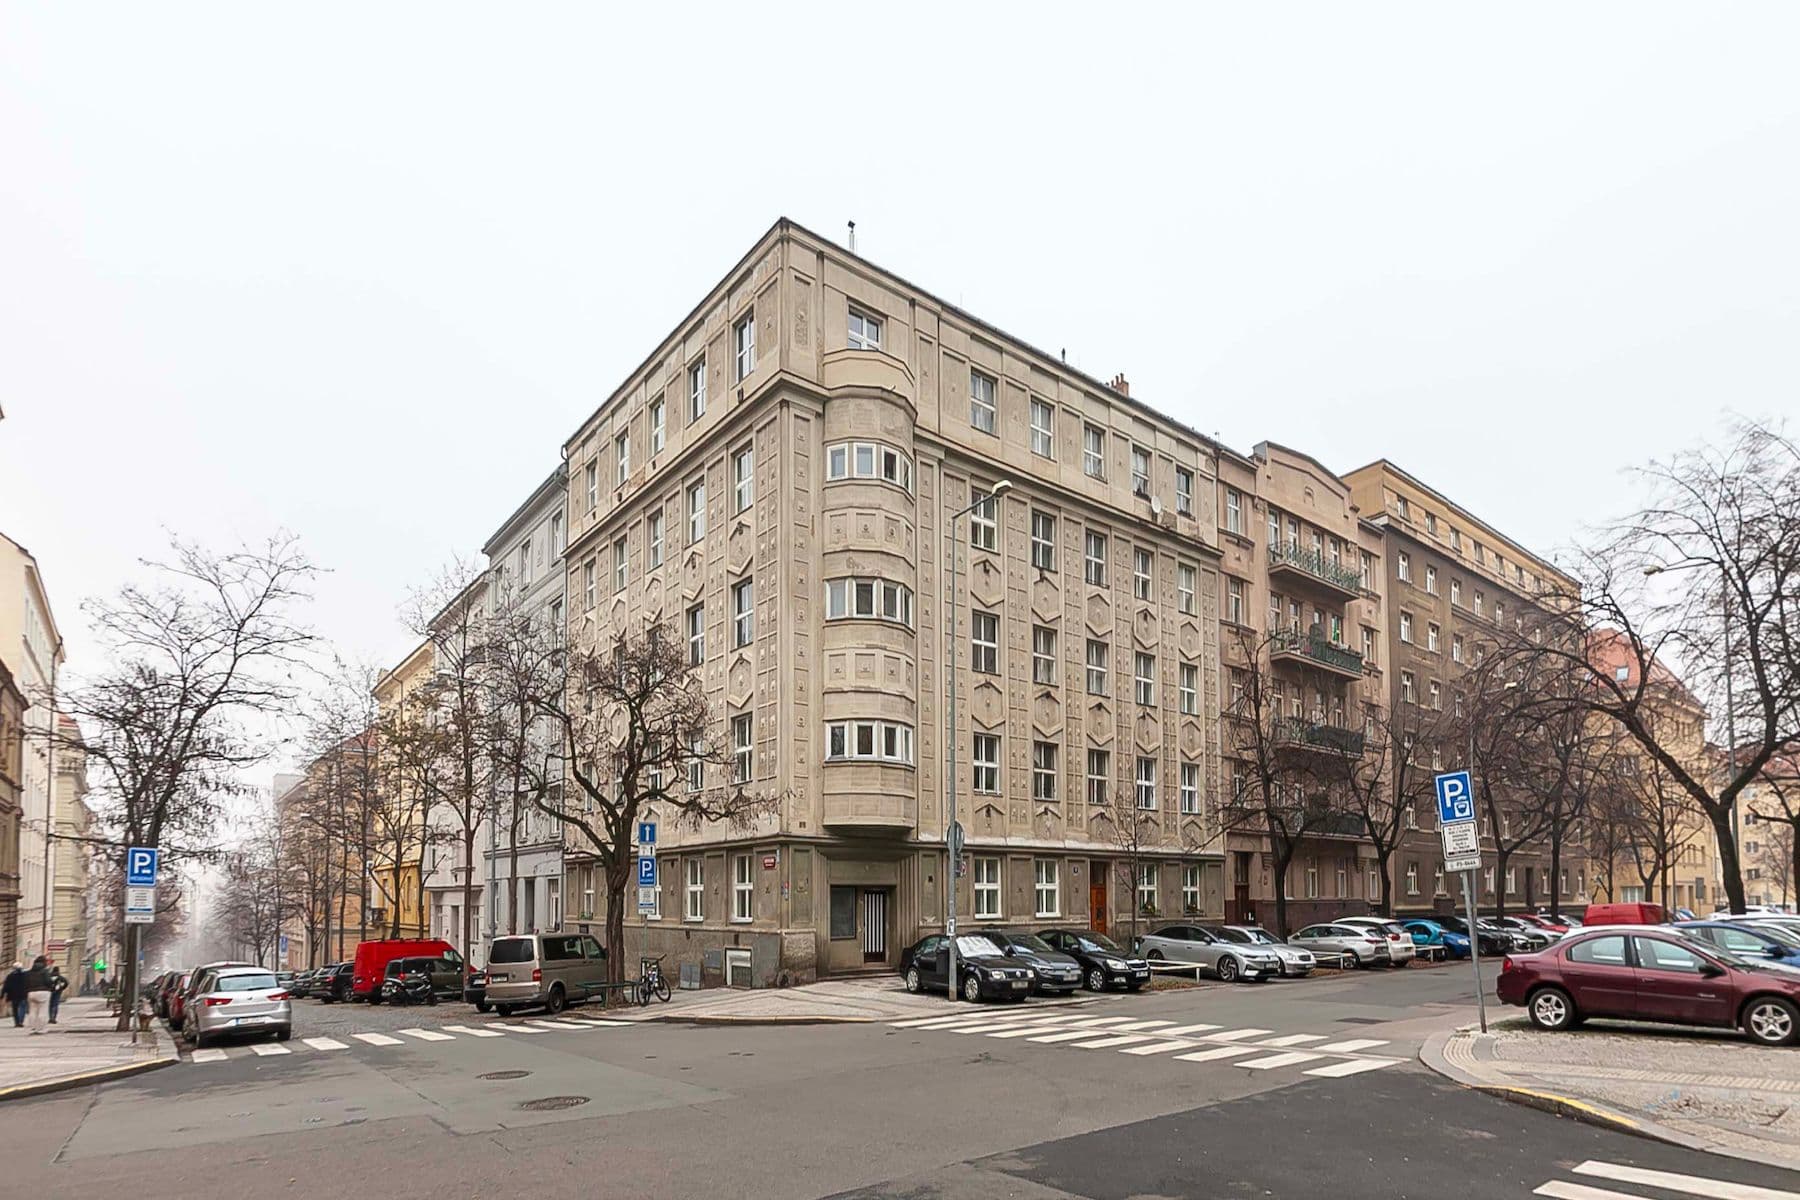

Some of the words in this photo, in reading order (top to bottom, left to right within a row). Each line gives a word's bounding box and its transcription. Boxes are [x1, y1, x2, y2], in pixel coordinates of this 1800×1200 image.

[1443, 779, 1463, 808] P
[134, 853, 151, 874] P
[642, 861, 652, 877] P
